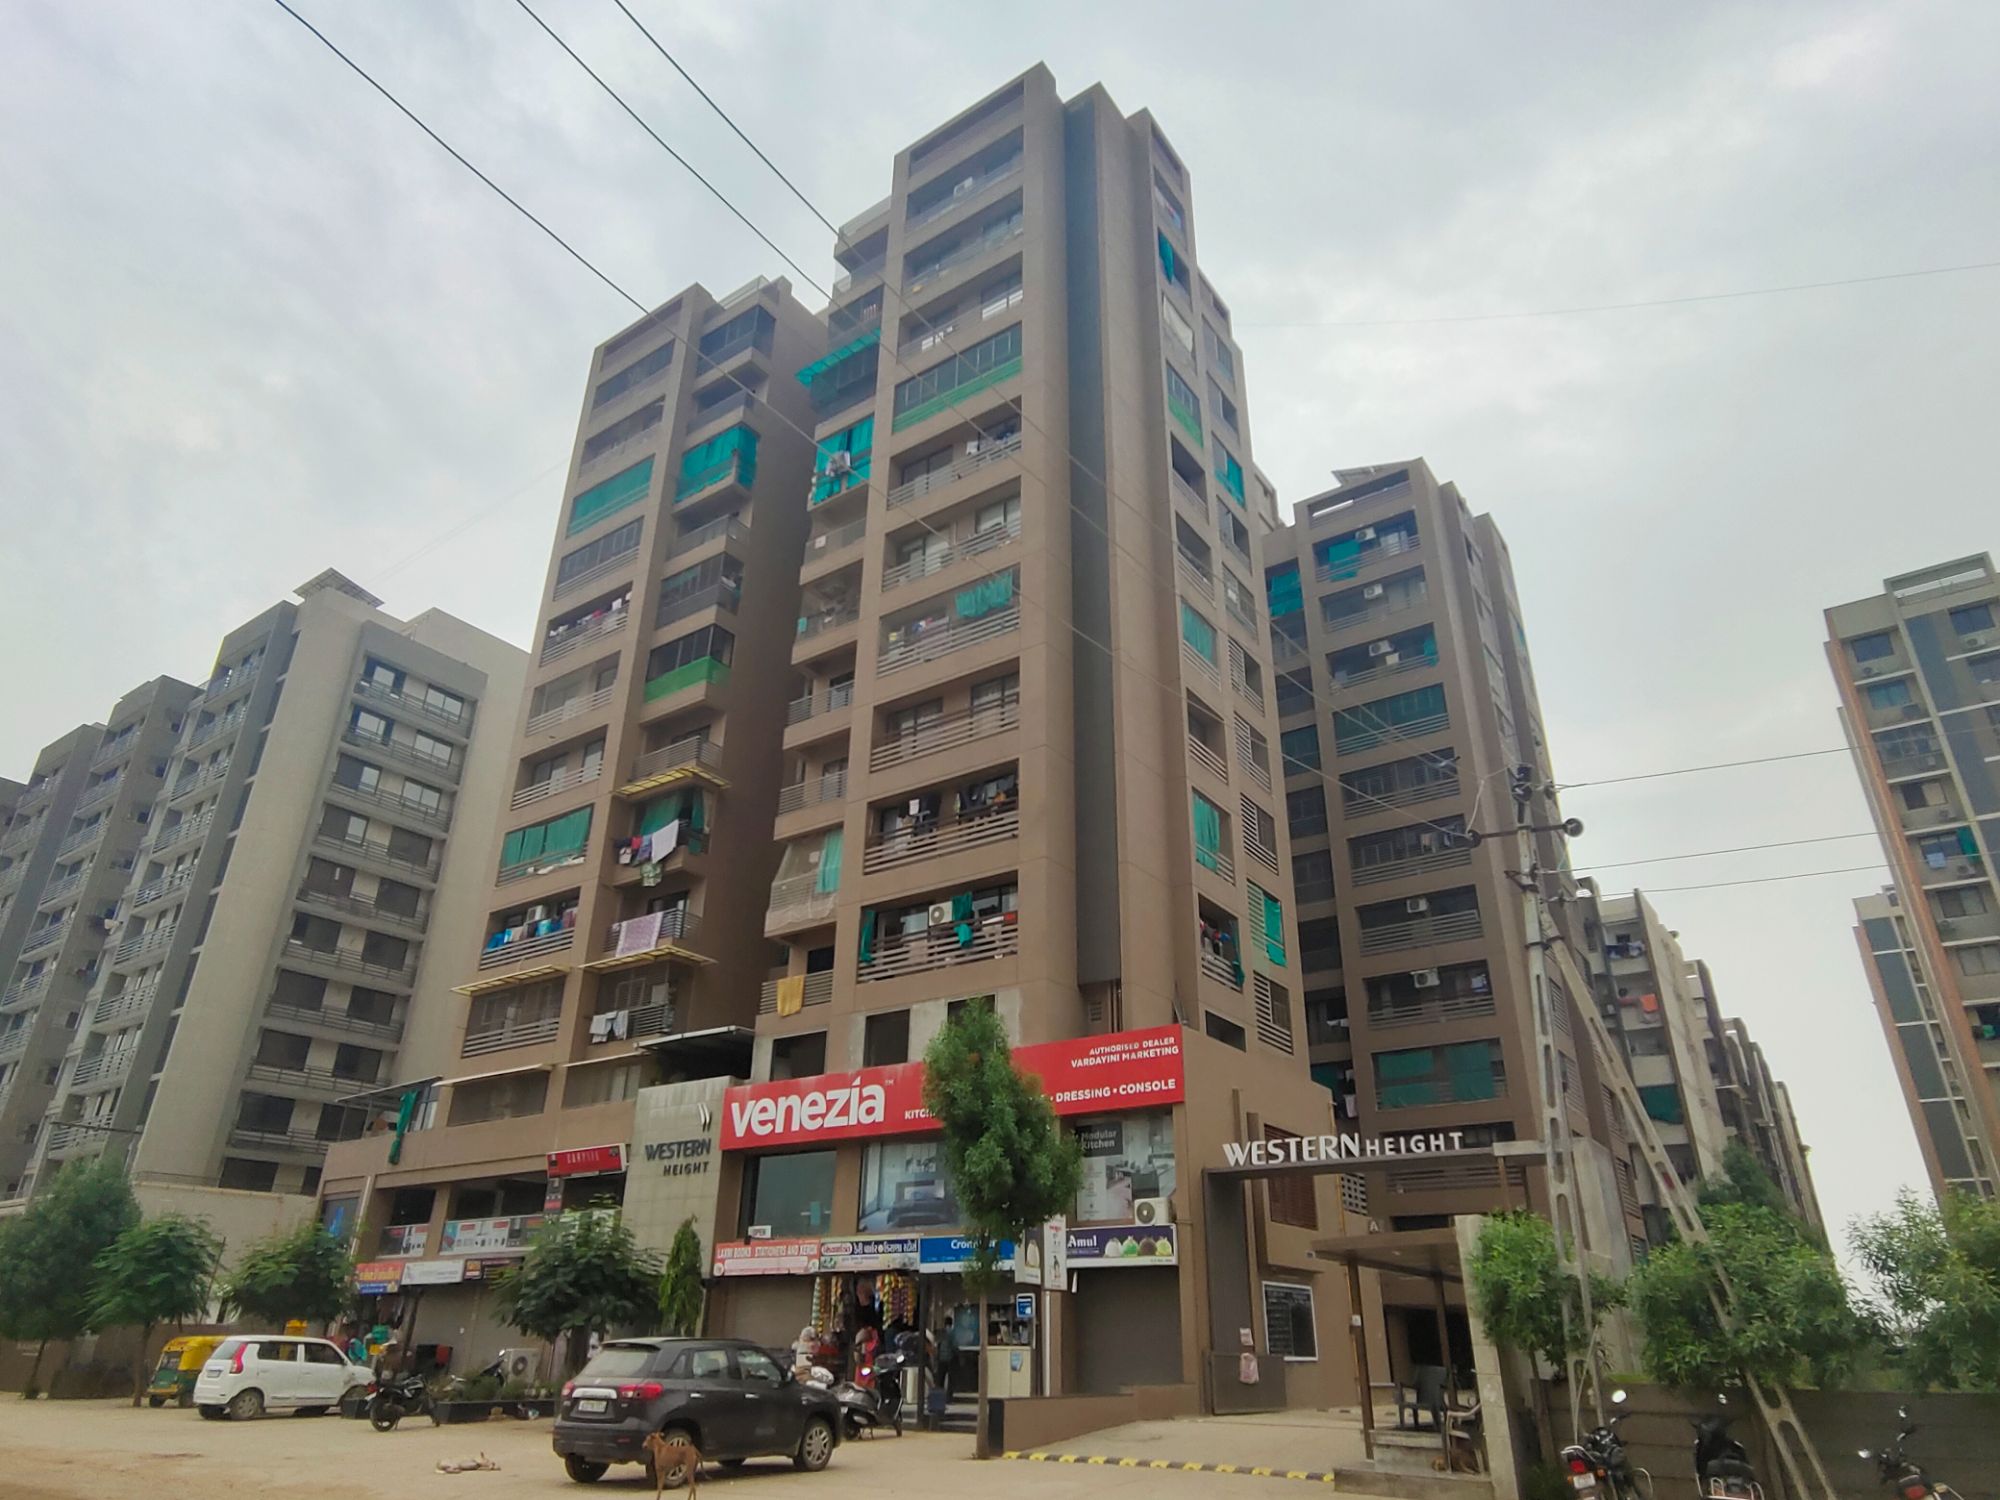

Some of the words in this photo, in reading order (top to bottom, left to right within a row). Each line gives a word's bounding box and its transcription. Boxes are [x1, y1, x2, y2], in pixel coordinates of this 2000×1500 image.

[1071, 1054, 1120, 1068] VARDAYINI
[1122, 1045, 1179, 1062] MARKETING
[1089, 1042, 1140, 1056] AUTHORISED
[1142, 1037, 1175, 1048] DEALER
[1055, 1087, 1111, 1103] DRESSING
[1119, 1079, 1176, 1095] CONSOLE
[645, 1139, 711, 1161] WESTERN
[1222, 1132, 1360, 1167] WESTERN
[1366, 1132, 1463, 1156] HEIGHT
[663, 1161, 710, 1176] HEIGHT
[1067, 1235, 1098, 1248] Amul
